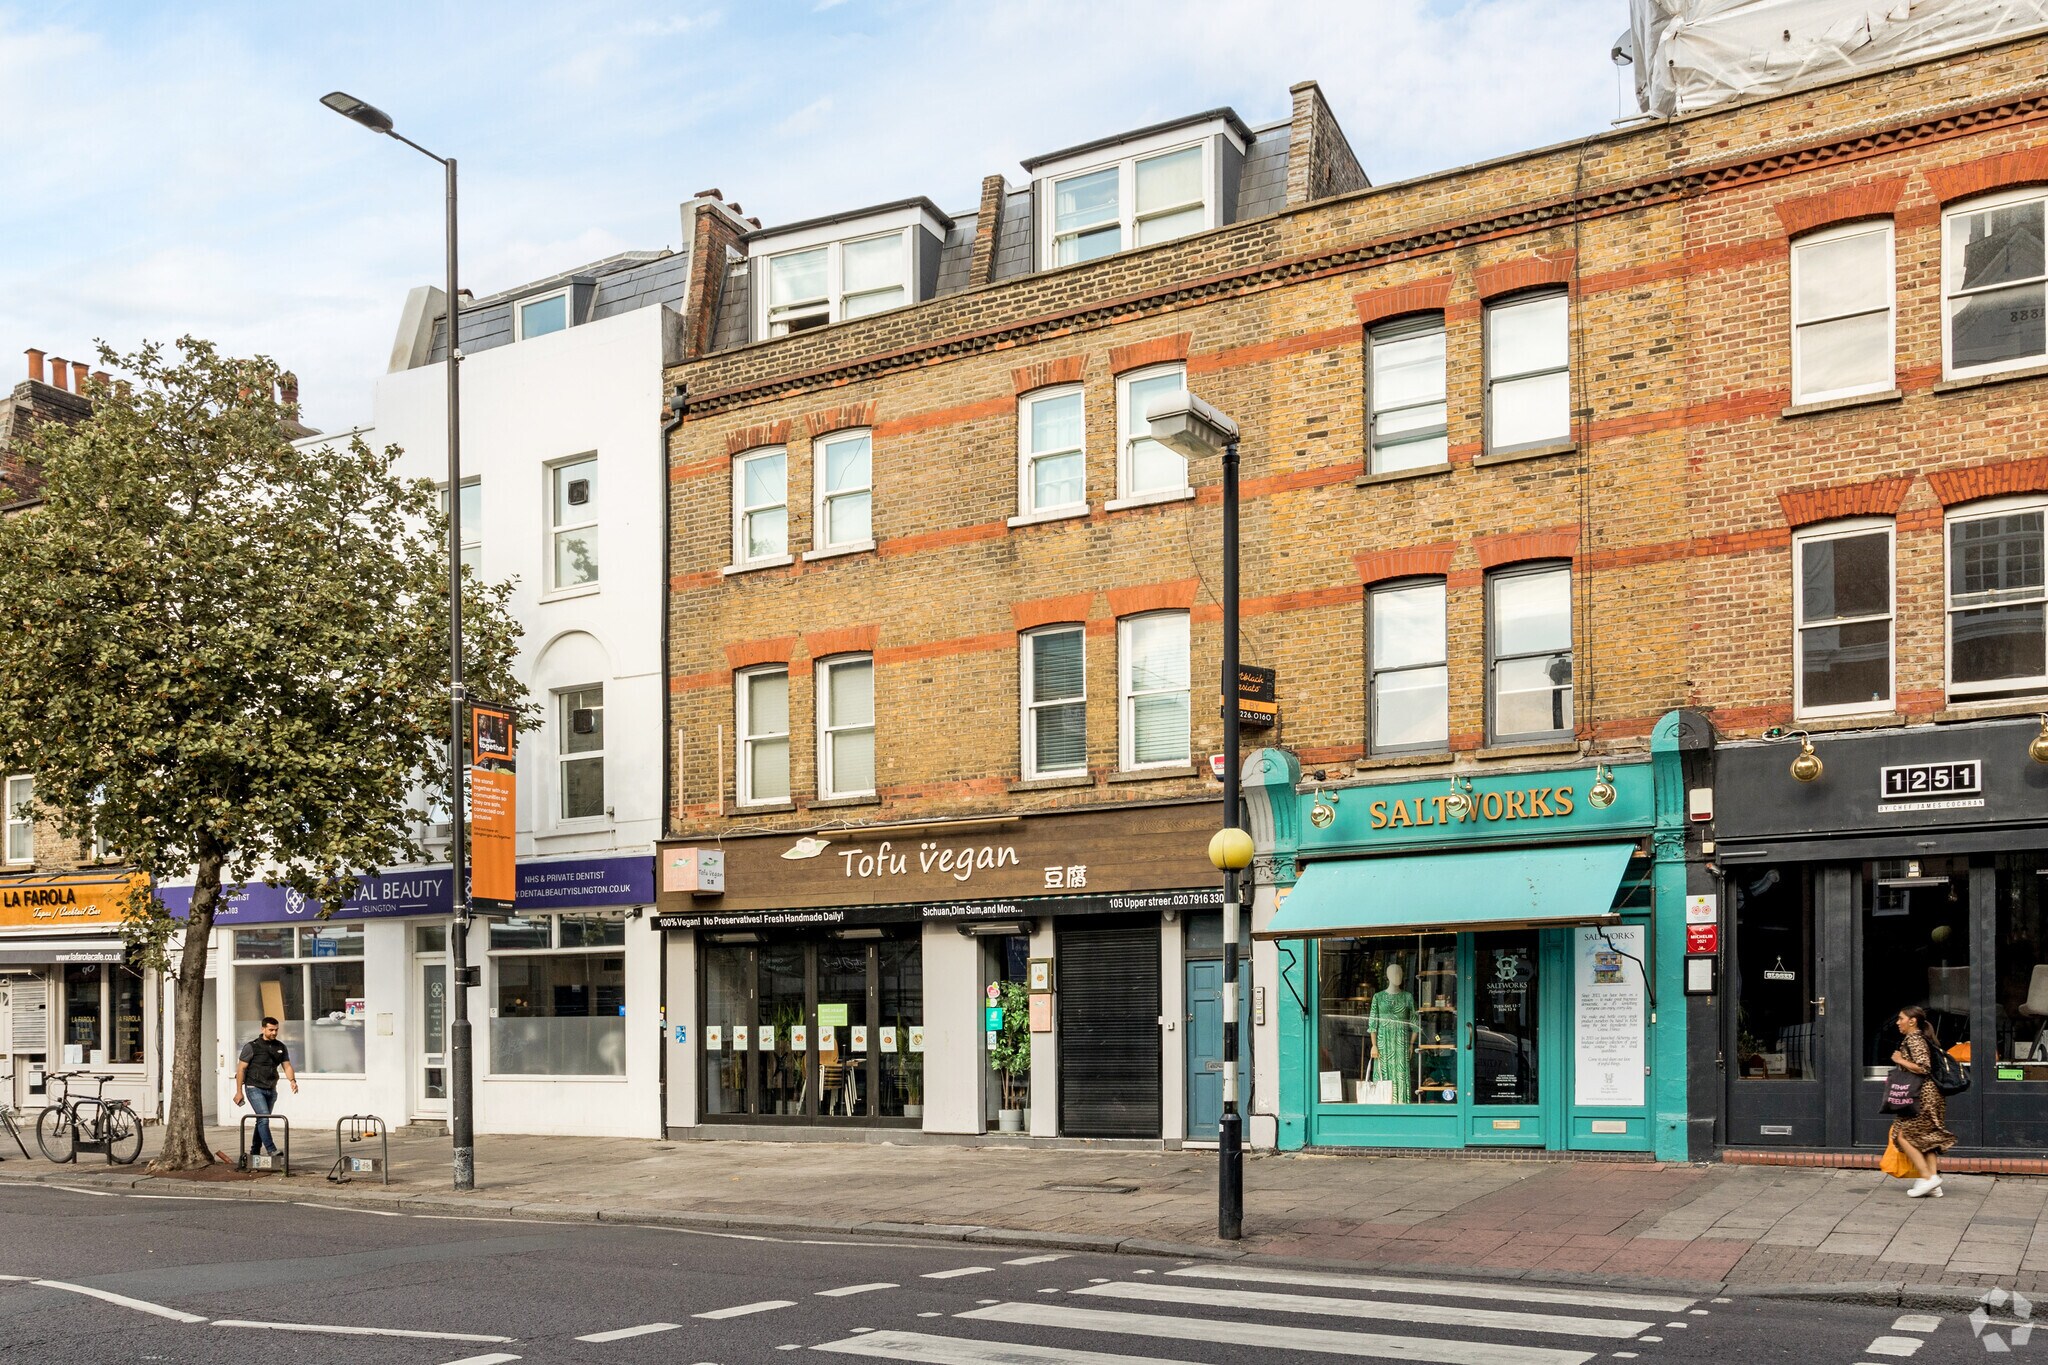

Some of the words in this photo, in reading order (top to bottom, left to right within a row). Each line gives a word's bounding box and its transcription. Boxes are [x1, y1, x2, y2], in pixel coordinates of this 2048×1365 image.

[1250, 702, 1260, 710] BY
[480, 743, 506, 752] together
[1892, 768, 1970, 791] 1251
[474, 784, 492, 792] together
[474, 792, 500, 801] communities
[1947, 800, 1983, 808] COCHRAN
[838, 841, 908, 878] Tofu
[525, 875, 539, 883] NHS
[547, 873, 575, 882] PRIVATE
[576, 871, 605, 881] DENTIST
[1044, 865, 1088, 889] 豆腐
[383, 880, 443, 900] BEAUTY
[4, 892, 21, 907] LA
[24, 888, 76, 907] FAROLA
[1110, 899, 1123, 908] 105
[1124, 898, 1147, 909] Upper
[1190, 894, 1208, 904] 7916
[60, 906, 87, 917] Cocktail
[362, 904, 397, 913] ISLINGTON
[997, 904, 1023, 913] More...
[677, 918, 700, 927] Vegan!
[704, 917, 713, 925] No
[714, 916, 763, 925] Preservatives!
[764, 914, 784, 924] Fresh
[785, 913, 823, 923] Handmade
[824, 912, 844, 922] Daily!
[56, 952, 121, 961] www.lafarolacafe.co.uk
